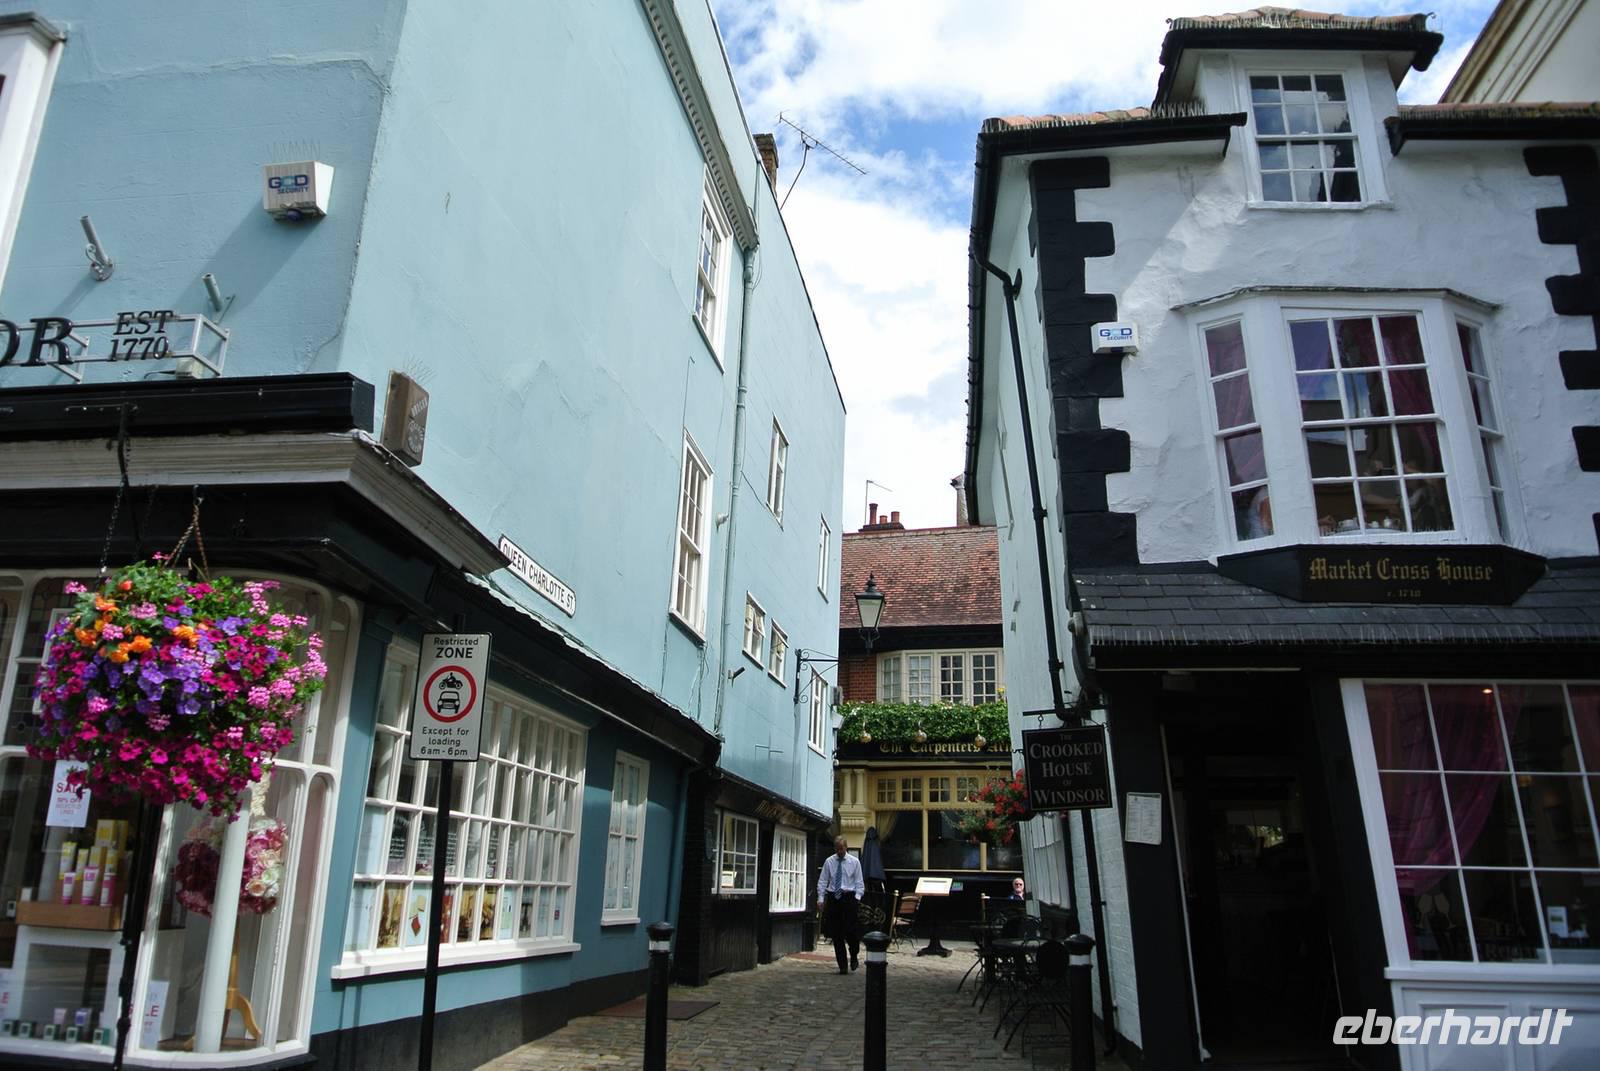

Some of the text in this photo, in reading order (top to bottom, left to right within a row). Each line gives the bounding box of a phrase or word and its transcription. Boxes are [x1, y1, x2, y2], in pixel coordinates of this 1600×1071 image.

[113, 310, 174, 335] EST
[107, 336, 170, 362] 1770
[1309, 557, 1494, 584] Market Cross House
[528, 564, 565, 604] CHARLOTTE
[433, 637, 479, 646] Restricted
[435, 647, 473, 659] ZONE
[422, 726, 470, 736] Except for
[428, 738, 461, 747] loading
[910, 742, 981, 755] Carpenters
[1030, 742, 1103, 759] CROOKED
[1041, 762, 1093, 778] HOUSE
[1033, 788, 1105, 805] WINDSOR
